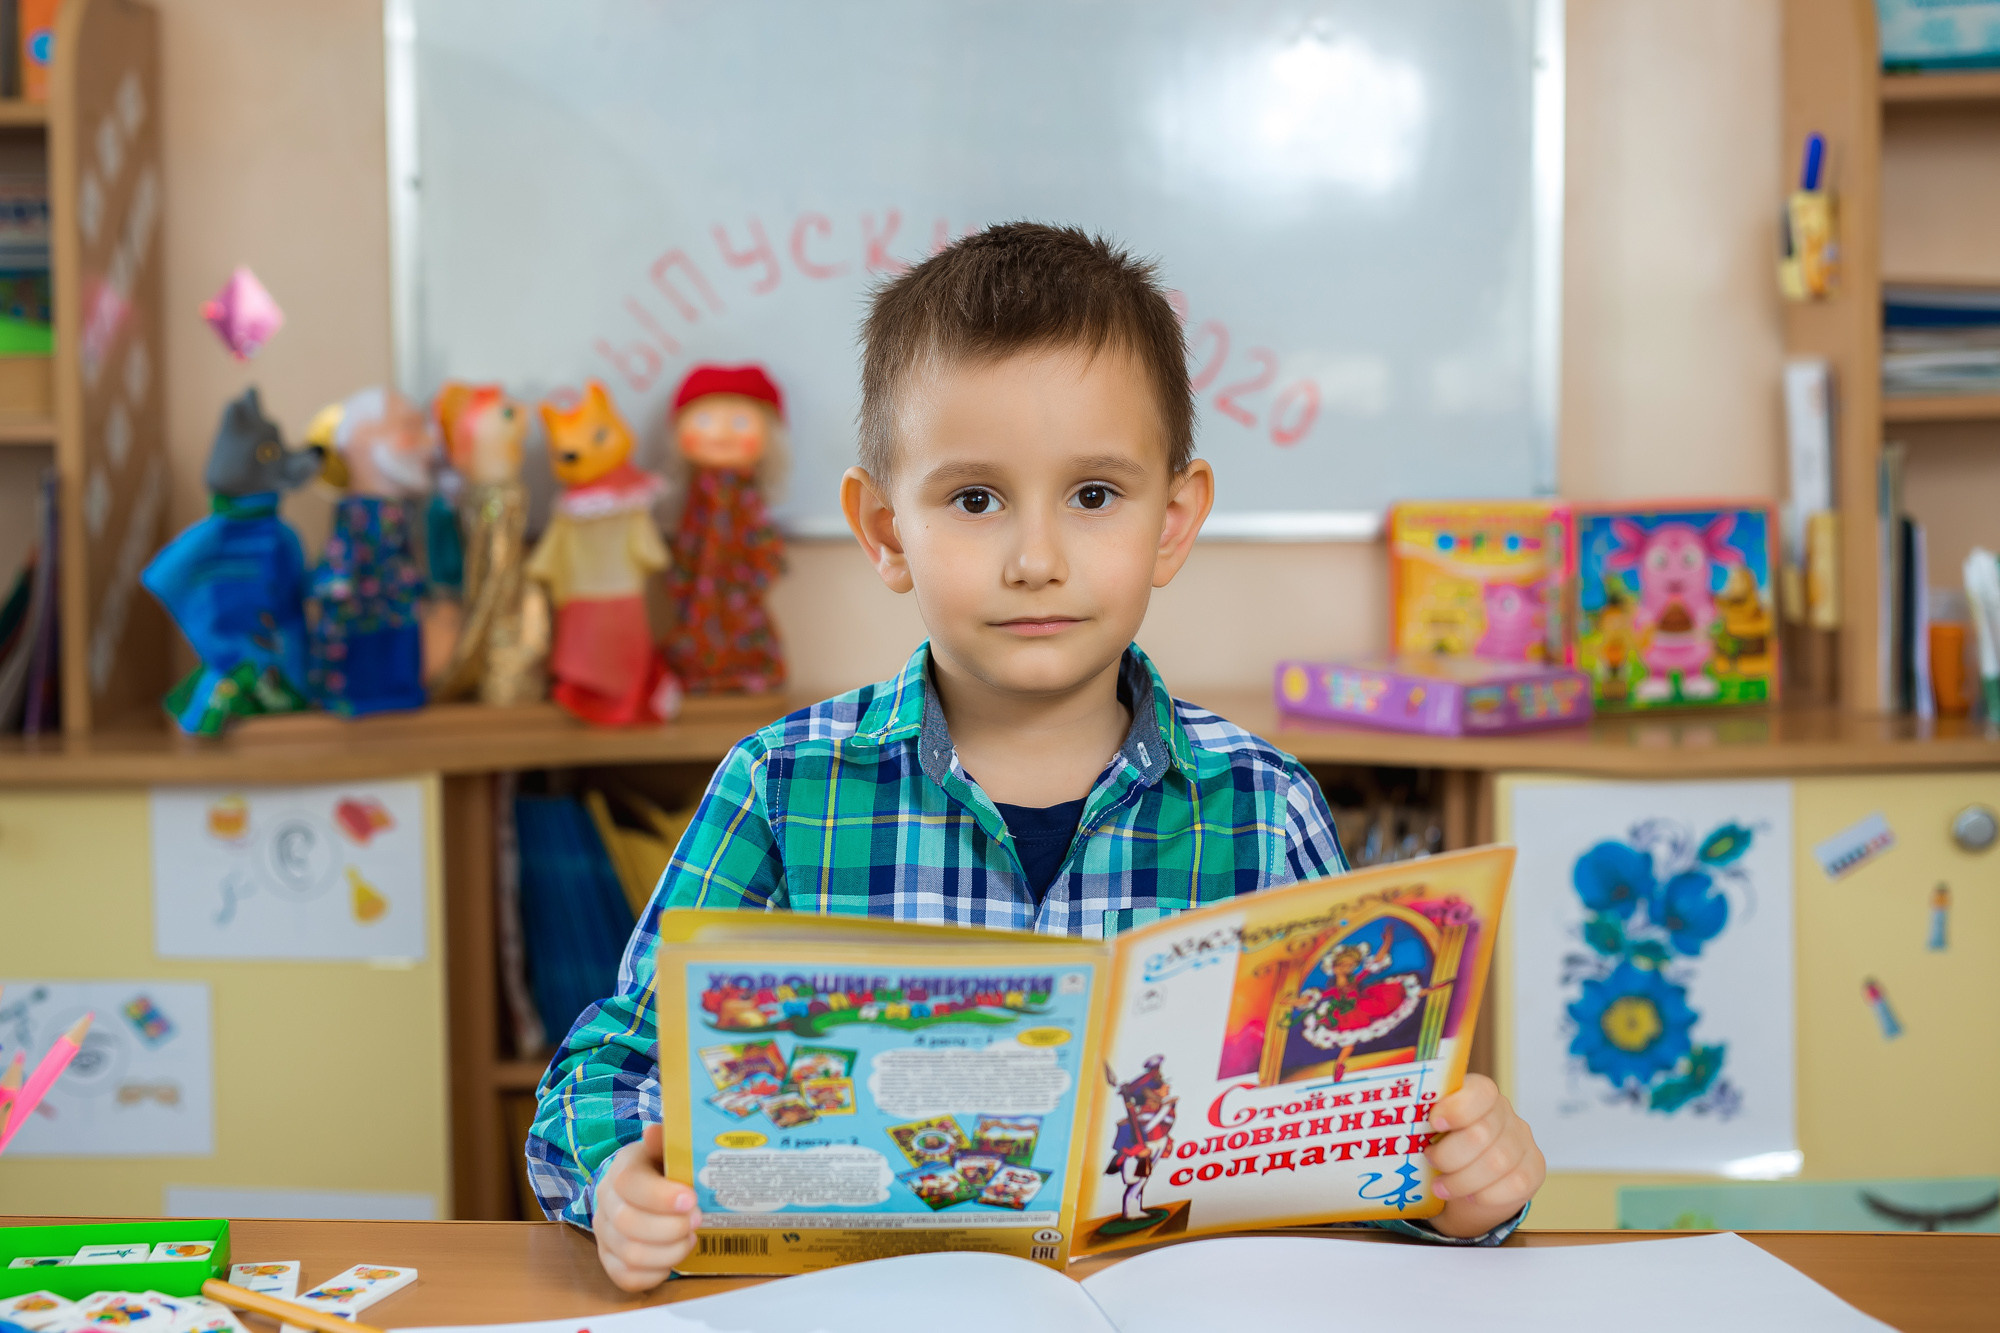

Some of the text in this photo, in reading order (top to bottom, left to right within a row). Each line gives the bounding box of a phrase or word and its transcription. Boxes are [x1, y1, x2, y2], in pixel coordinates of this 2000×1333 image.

[1176, 1091, 1437, 1159] оловянный
[1207, 1078, 1414, 1129] Стойкий
[1169, 1132, 1438, 1186] солдатик
